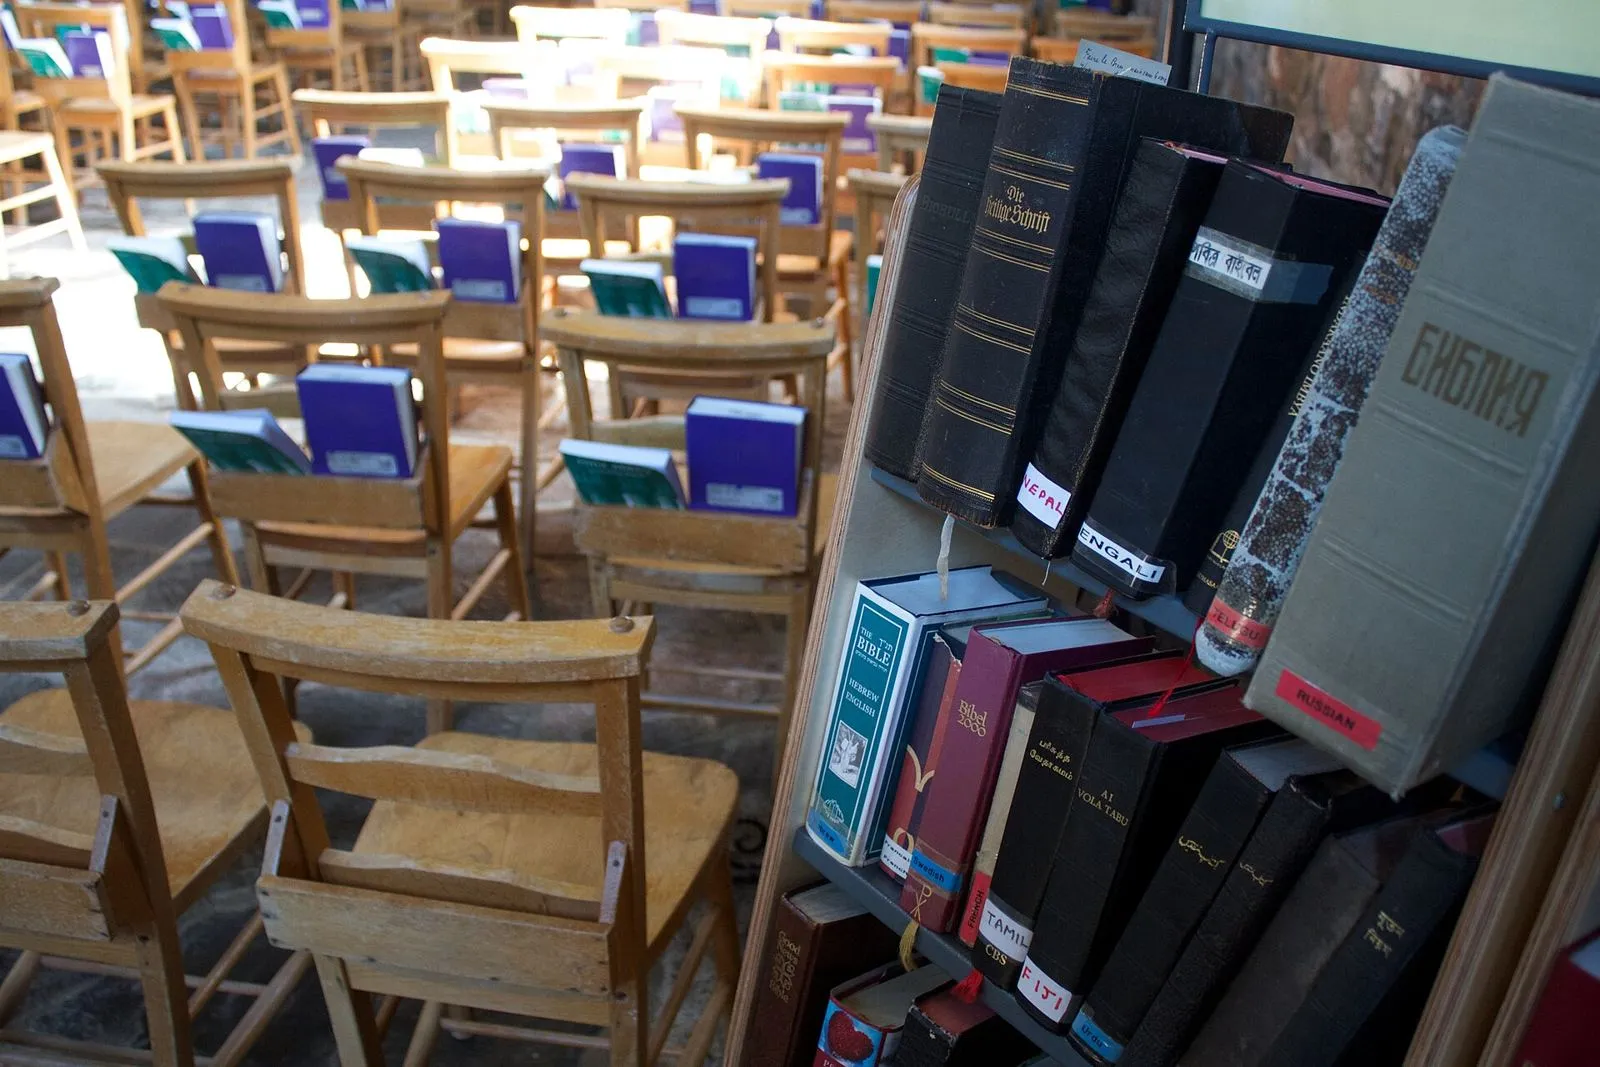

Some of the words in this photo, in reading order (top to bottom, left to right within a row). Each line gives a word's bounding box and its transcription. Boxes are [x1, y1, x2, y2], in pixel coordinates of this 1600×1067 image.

[1007, 185, 1025, 202] Die
[1010, 204, 1051, 235] Schrift
[1401, 321, 1550, 438] БИБЛИЯ
[1023, 474, 1064, 516] NEPAL
[1078, 525, 1158, 582] ENGALI
[860, 626, 873, 640] THE
[856, 636, 891, 667] BIBLE
[845, 691, 876, 718] ENGLISH
[848, 677, 880, 702] HEBREW
[957, 713, 987, 737] 2000
[958, 699, 988, 728] Bibel
[1297, 688, 1357, 731] RUSSIAN
[1077, 787, 1102, 811] VOLA
[1104, 804, 1129, 826] TABU
[912, 856, 945, 883] Swedish
[987, 910, 1029, 949] TAMIL
[985, 944, 1008, 966] CBS
[1022, 966, 1063, 1010] FIJI
